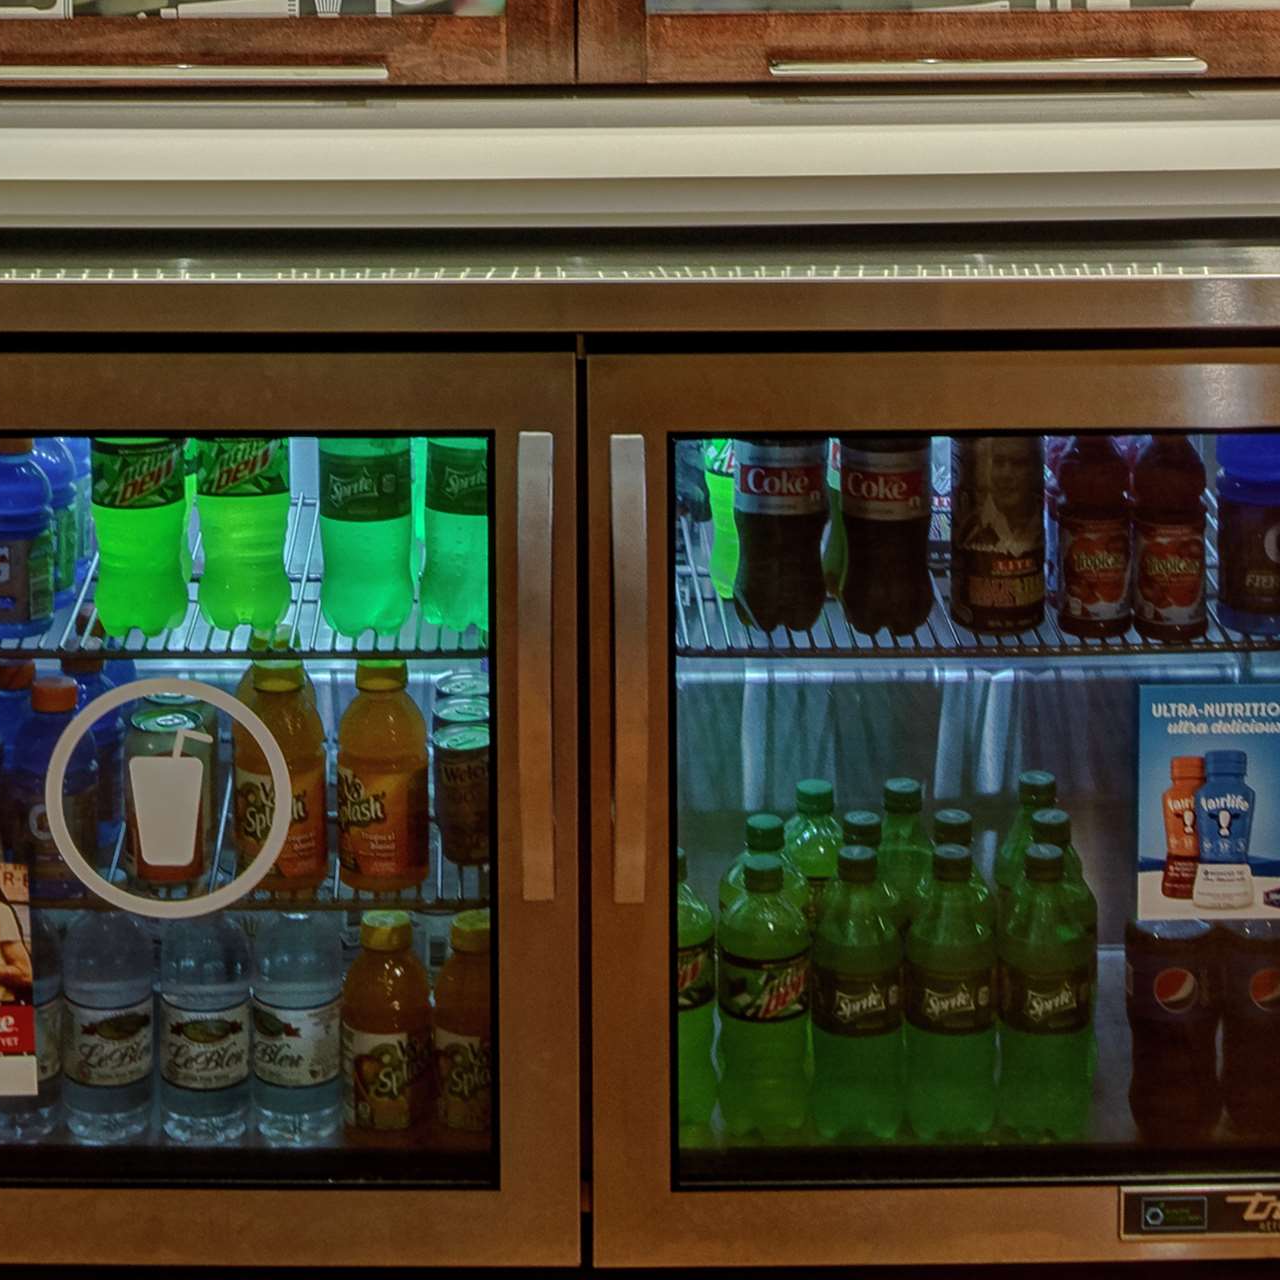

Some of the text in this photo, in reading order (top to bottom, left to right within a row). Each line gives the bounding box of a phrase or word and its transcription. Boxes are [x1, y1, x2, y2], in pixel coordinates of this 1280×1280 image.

[330, 472, 373, 503] Sprite
[747, 467, 809, 495] Coke
[847, 470, 908, 501] Coke
[1167, 719, 1207, 735] ultra
[245, 797, 305, 839] Splh
[1200, 793, 1250, 812] fairlife
[835, 985, 882, 1018] Sprite
[926, 985, 971, 1017] Sprite
[1028, 985, 1073, 1017] Sprite
[0, 1036, 19, 1047] YET
